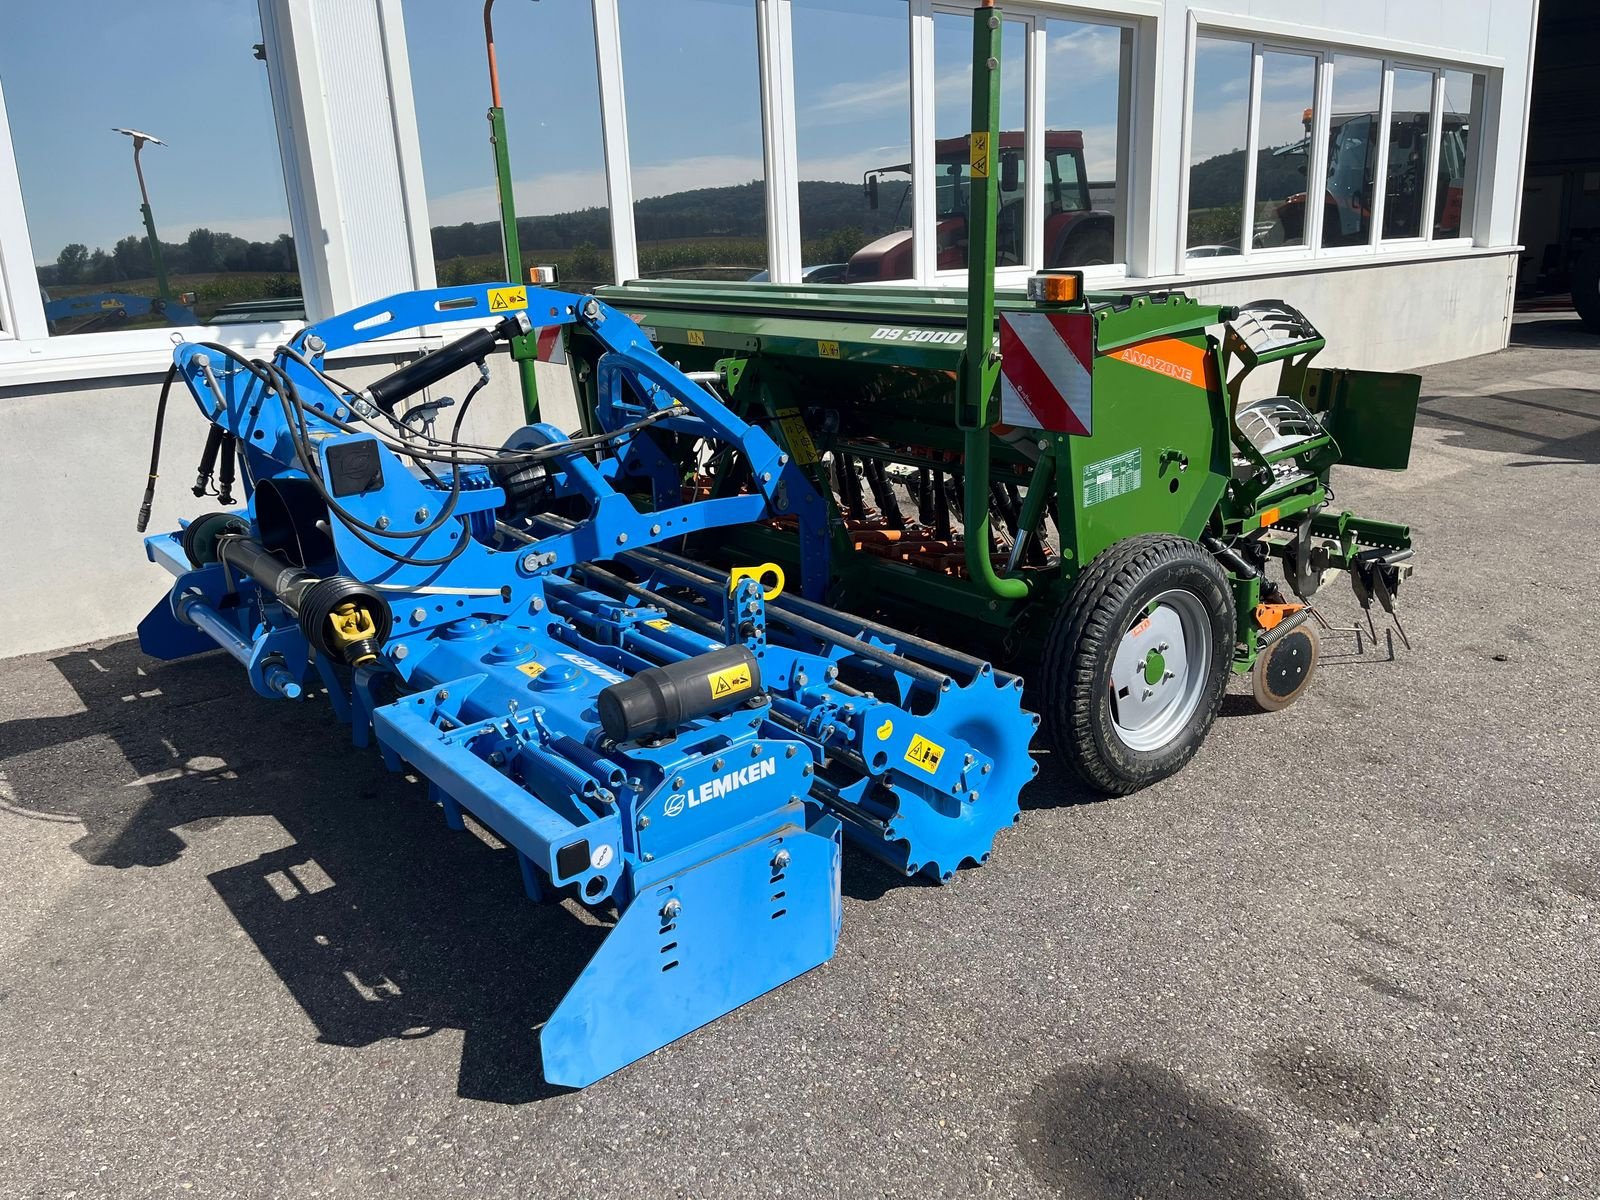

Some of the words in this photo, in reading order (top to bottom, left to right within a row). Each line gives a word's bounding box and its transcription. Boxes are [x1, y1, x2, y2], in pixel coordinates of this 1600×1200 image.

[871, 328, 904, 340] D9
[902, 330, 965, 344] 3000
[1121, 349, 1193, 382] AMAZONE
[687, 757, 776, 808] LEMKEN
